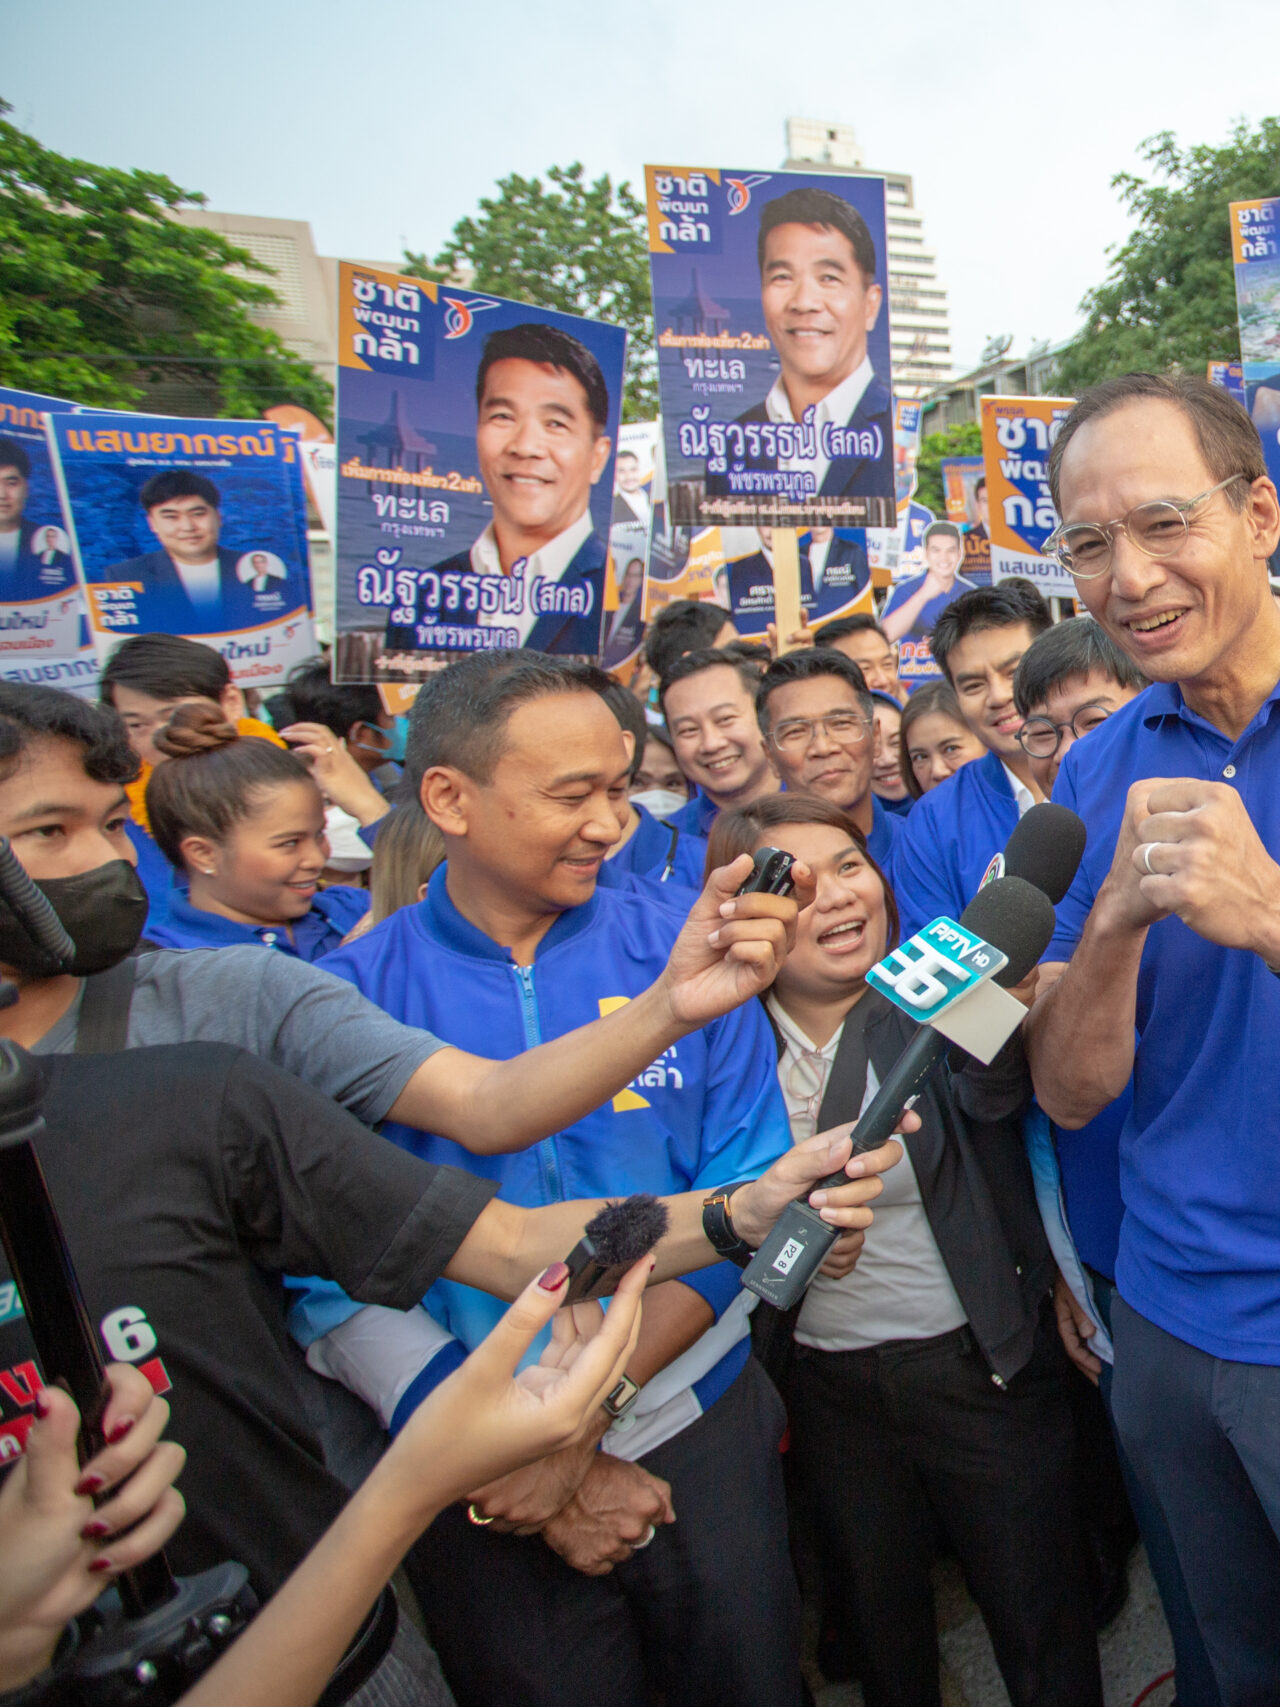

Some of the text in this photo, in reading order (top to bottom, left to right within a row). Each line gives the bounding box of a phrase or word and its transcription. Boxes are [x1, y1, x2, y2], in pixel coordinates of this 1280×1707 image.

[654, 172, 708, 197] ชาติ
[656, 196, 710, 215] พัฒนา
[658, 214, 711, 242] กล้า
[1241, 235, 1277, 258] กล้า
[352, 279, 421, 312] ชาติ
[352, 302, 421, 333] พัฒนา
[352, 328, 421, 365] กล้า
[684, 357, 746, 380] ทะเล
[66, 429, 276, 457] แสนยากรณ์
[822, 424, 884, 459] (สกล)
[371, 493, 450, 524] ทะเล
[357, 549, 595, 624] ณัฐวรรธน์ (สกล)
[929, 922, 991, 968] PPTV HD
